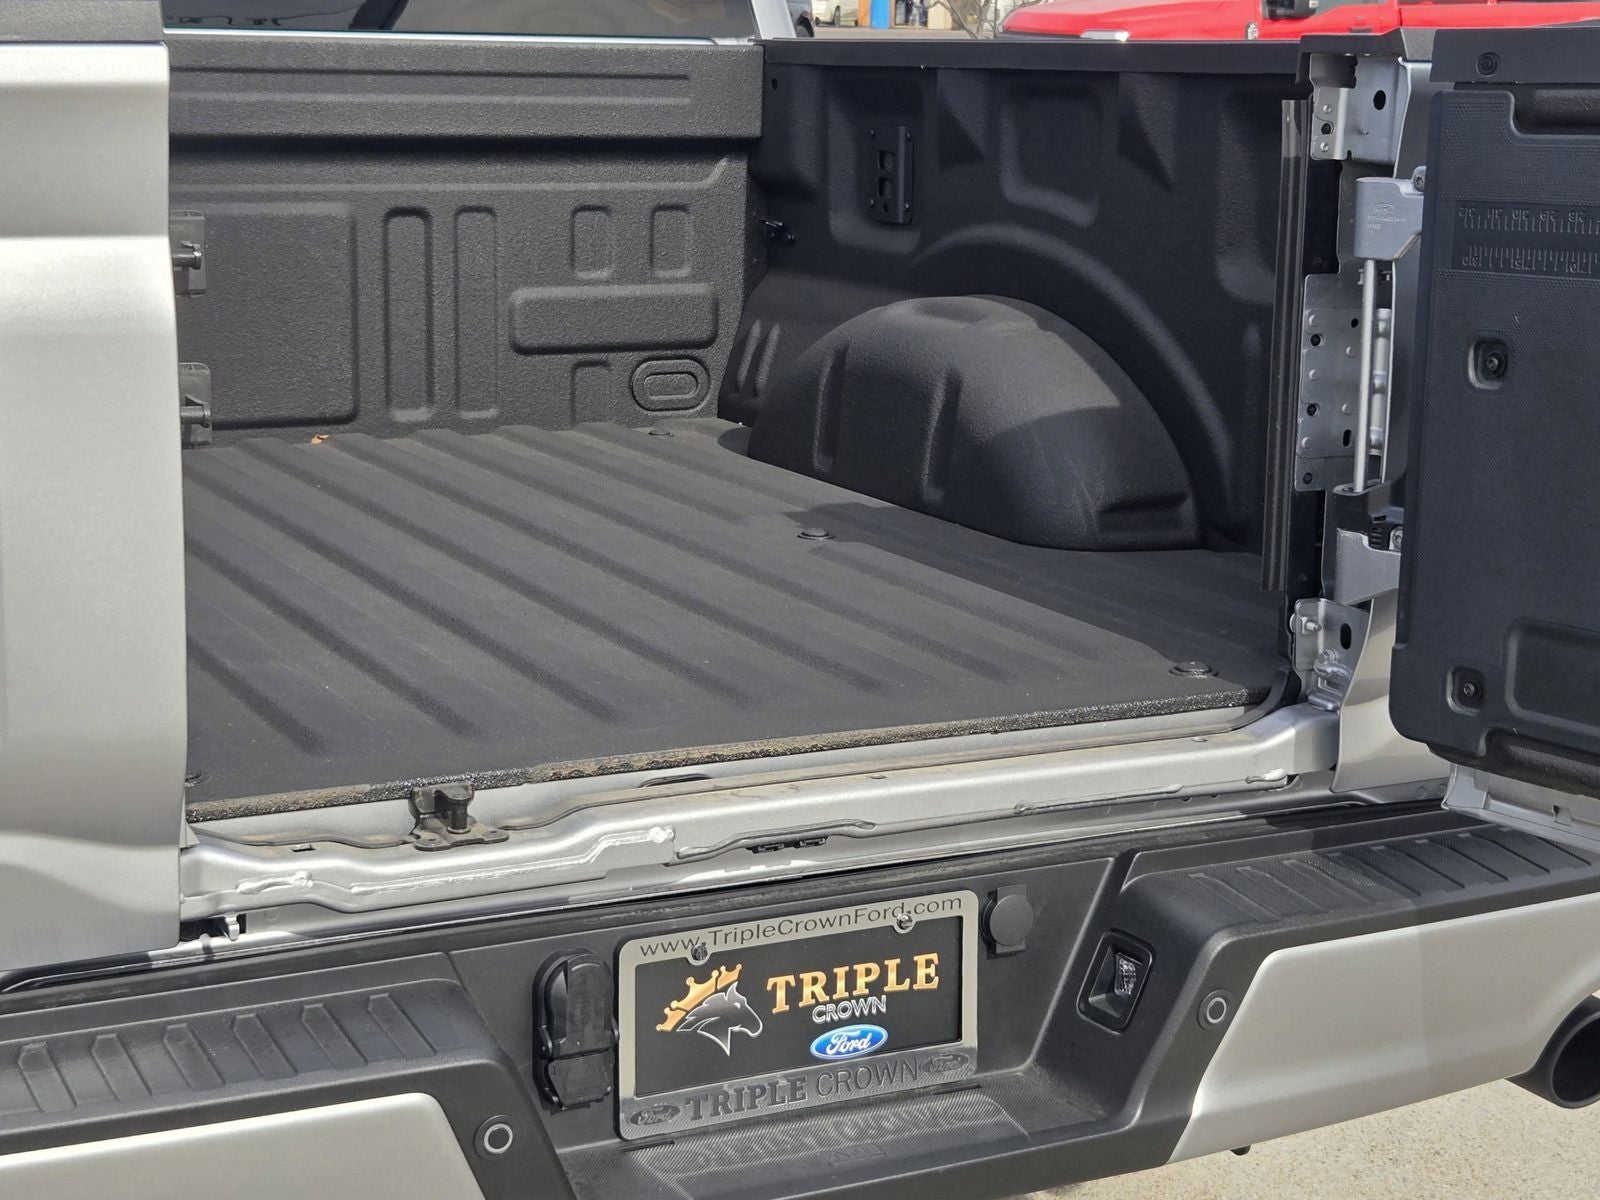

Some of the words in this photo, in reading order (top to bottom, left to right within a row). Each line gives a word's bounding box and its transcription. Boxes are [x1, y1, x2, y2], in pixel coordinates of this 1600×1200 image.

[640, 896, 962, 957] www.TripleCrownFord.com
[766, 952, 940, 1015] TRIPLE
[812, 995, 887, 1024] CROWN
[825, 1028, 873, 1055] Ford
[636, 1105, 673, 1125] Ford
[685, 1074, 808, 1121] TRIPLE
[816, 1056, 919, 1098] CROWN
[928, 1055, 962, 1073] Ford
